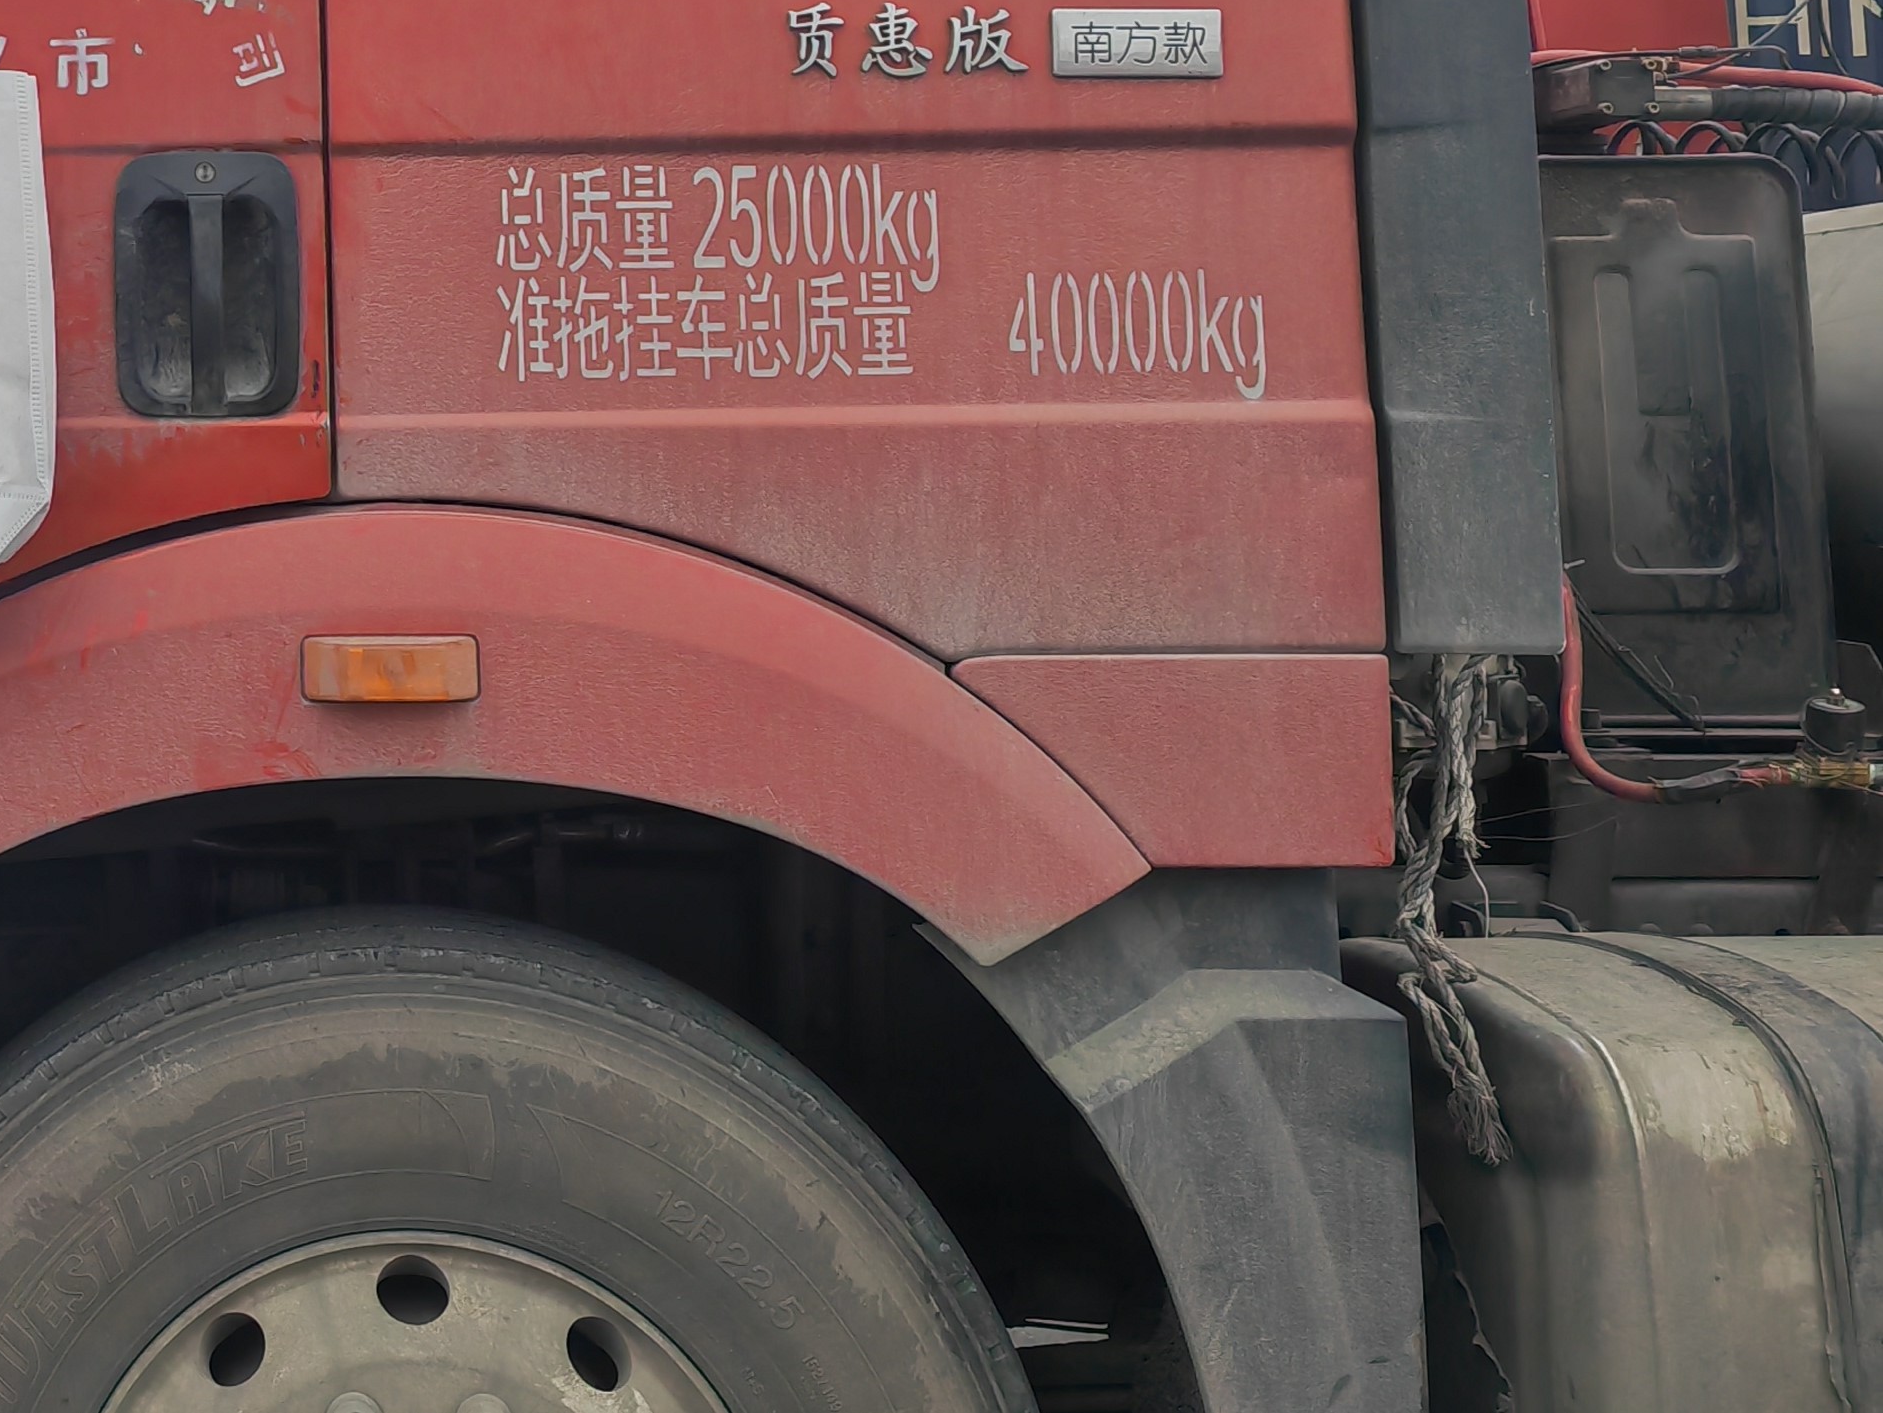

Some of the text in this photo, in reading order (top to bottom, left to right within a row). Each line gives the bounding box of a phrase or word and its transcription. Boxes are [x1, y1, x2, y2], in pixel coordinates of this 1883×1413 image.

[1070, 21, 1209, 66] 南方款
[495, 163, 941, 292] 总质量 25000kg
[497, 268, 1267, 400] 准拖挂车总质量 40000kg
[655, 1190, 806, 1331] 12R22.5
